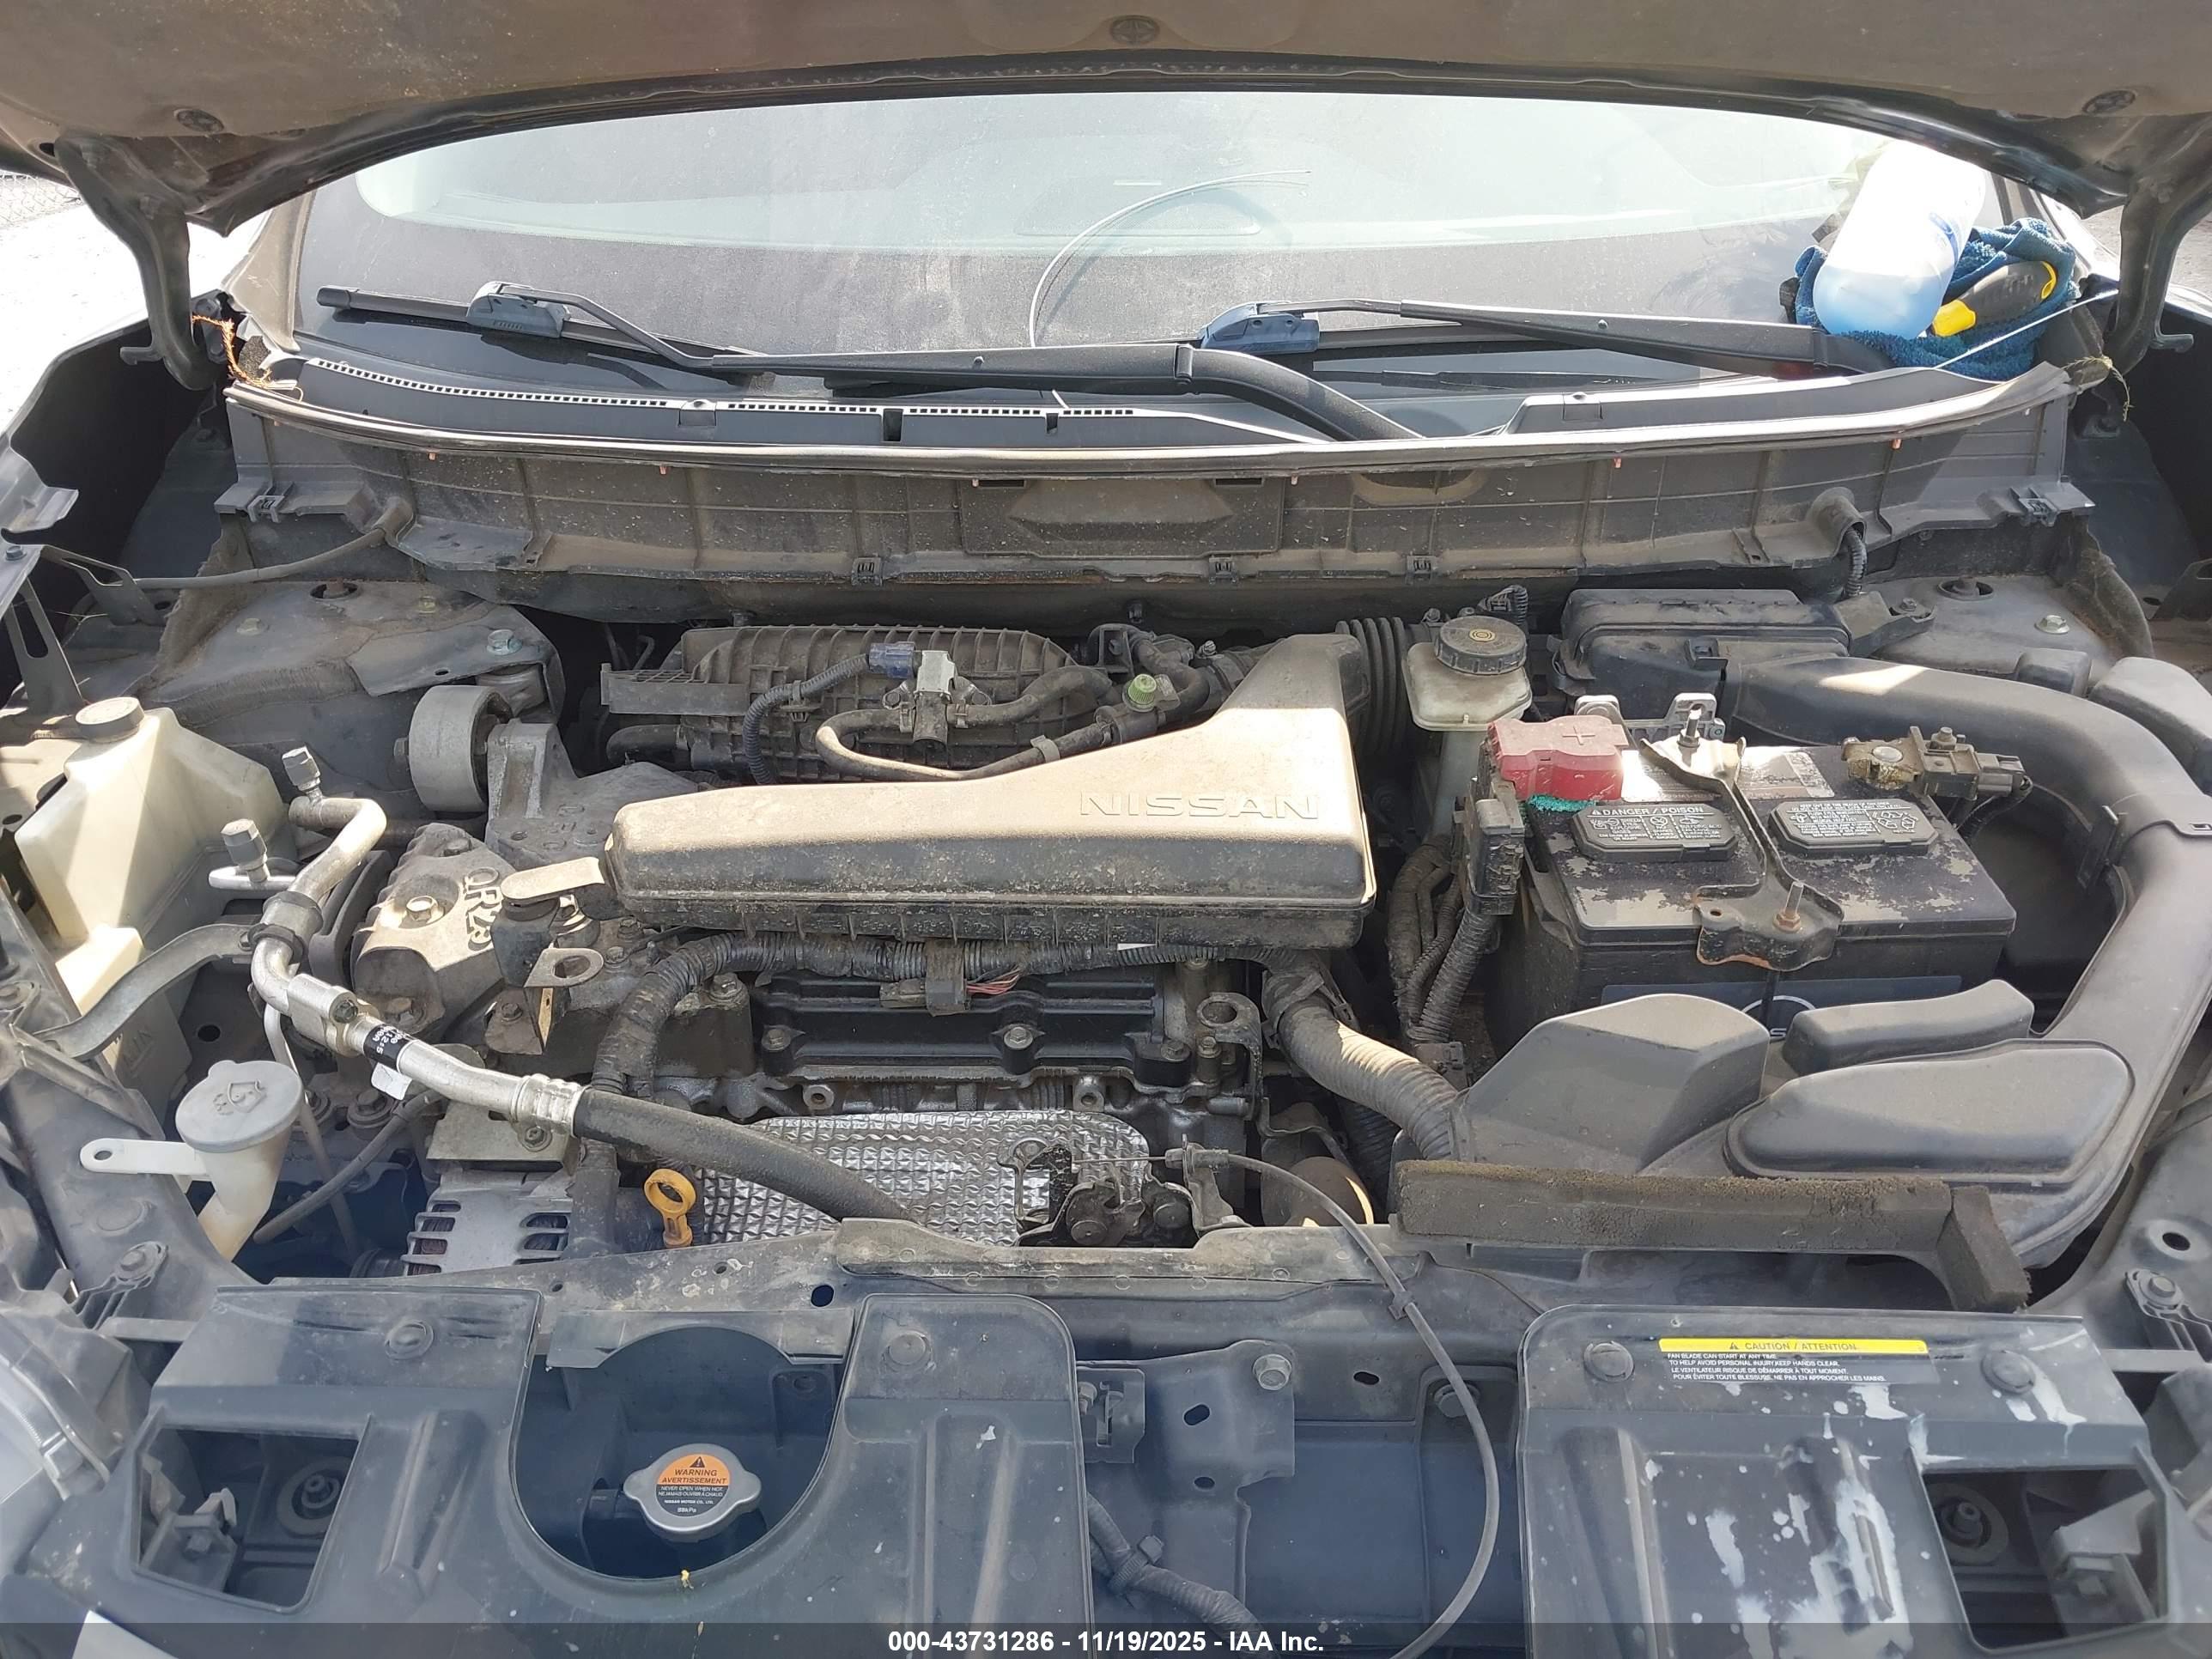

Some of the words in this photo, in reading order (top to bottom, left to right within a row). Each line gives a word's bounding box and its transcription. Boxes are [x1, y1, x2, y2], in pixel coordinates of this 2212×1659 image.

[1080, 790, 1318, 819] NISSAN
[1602, 808, 1650, 817] DANGER
[1662, 806, 1704, 815] POISON
